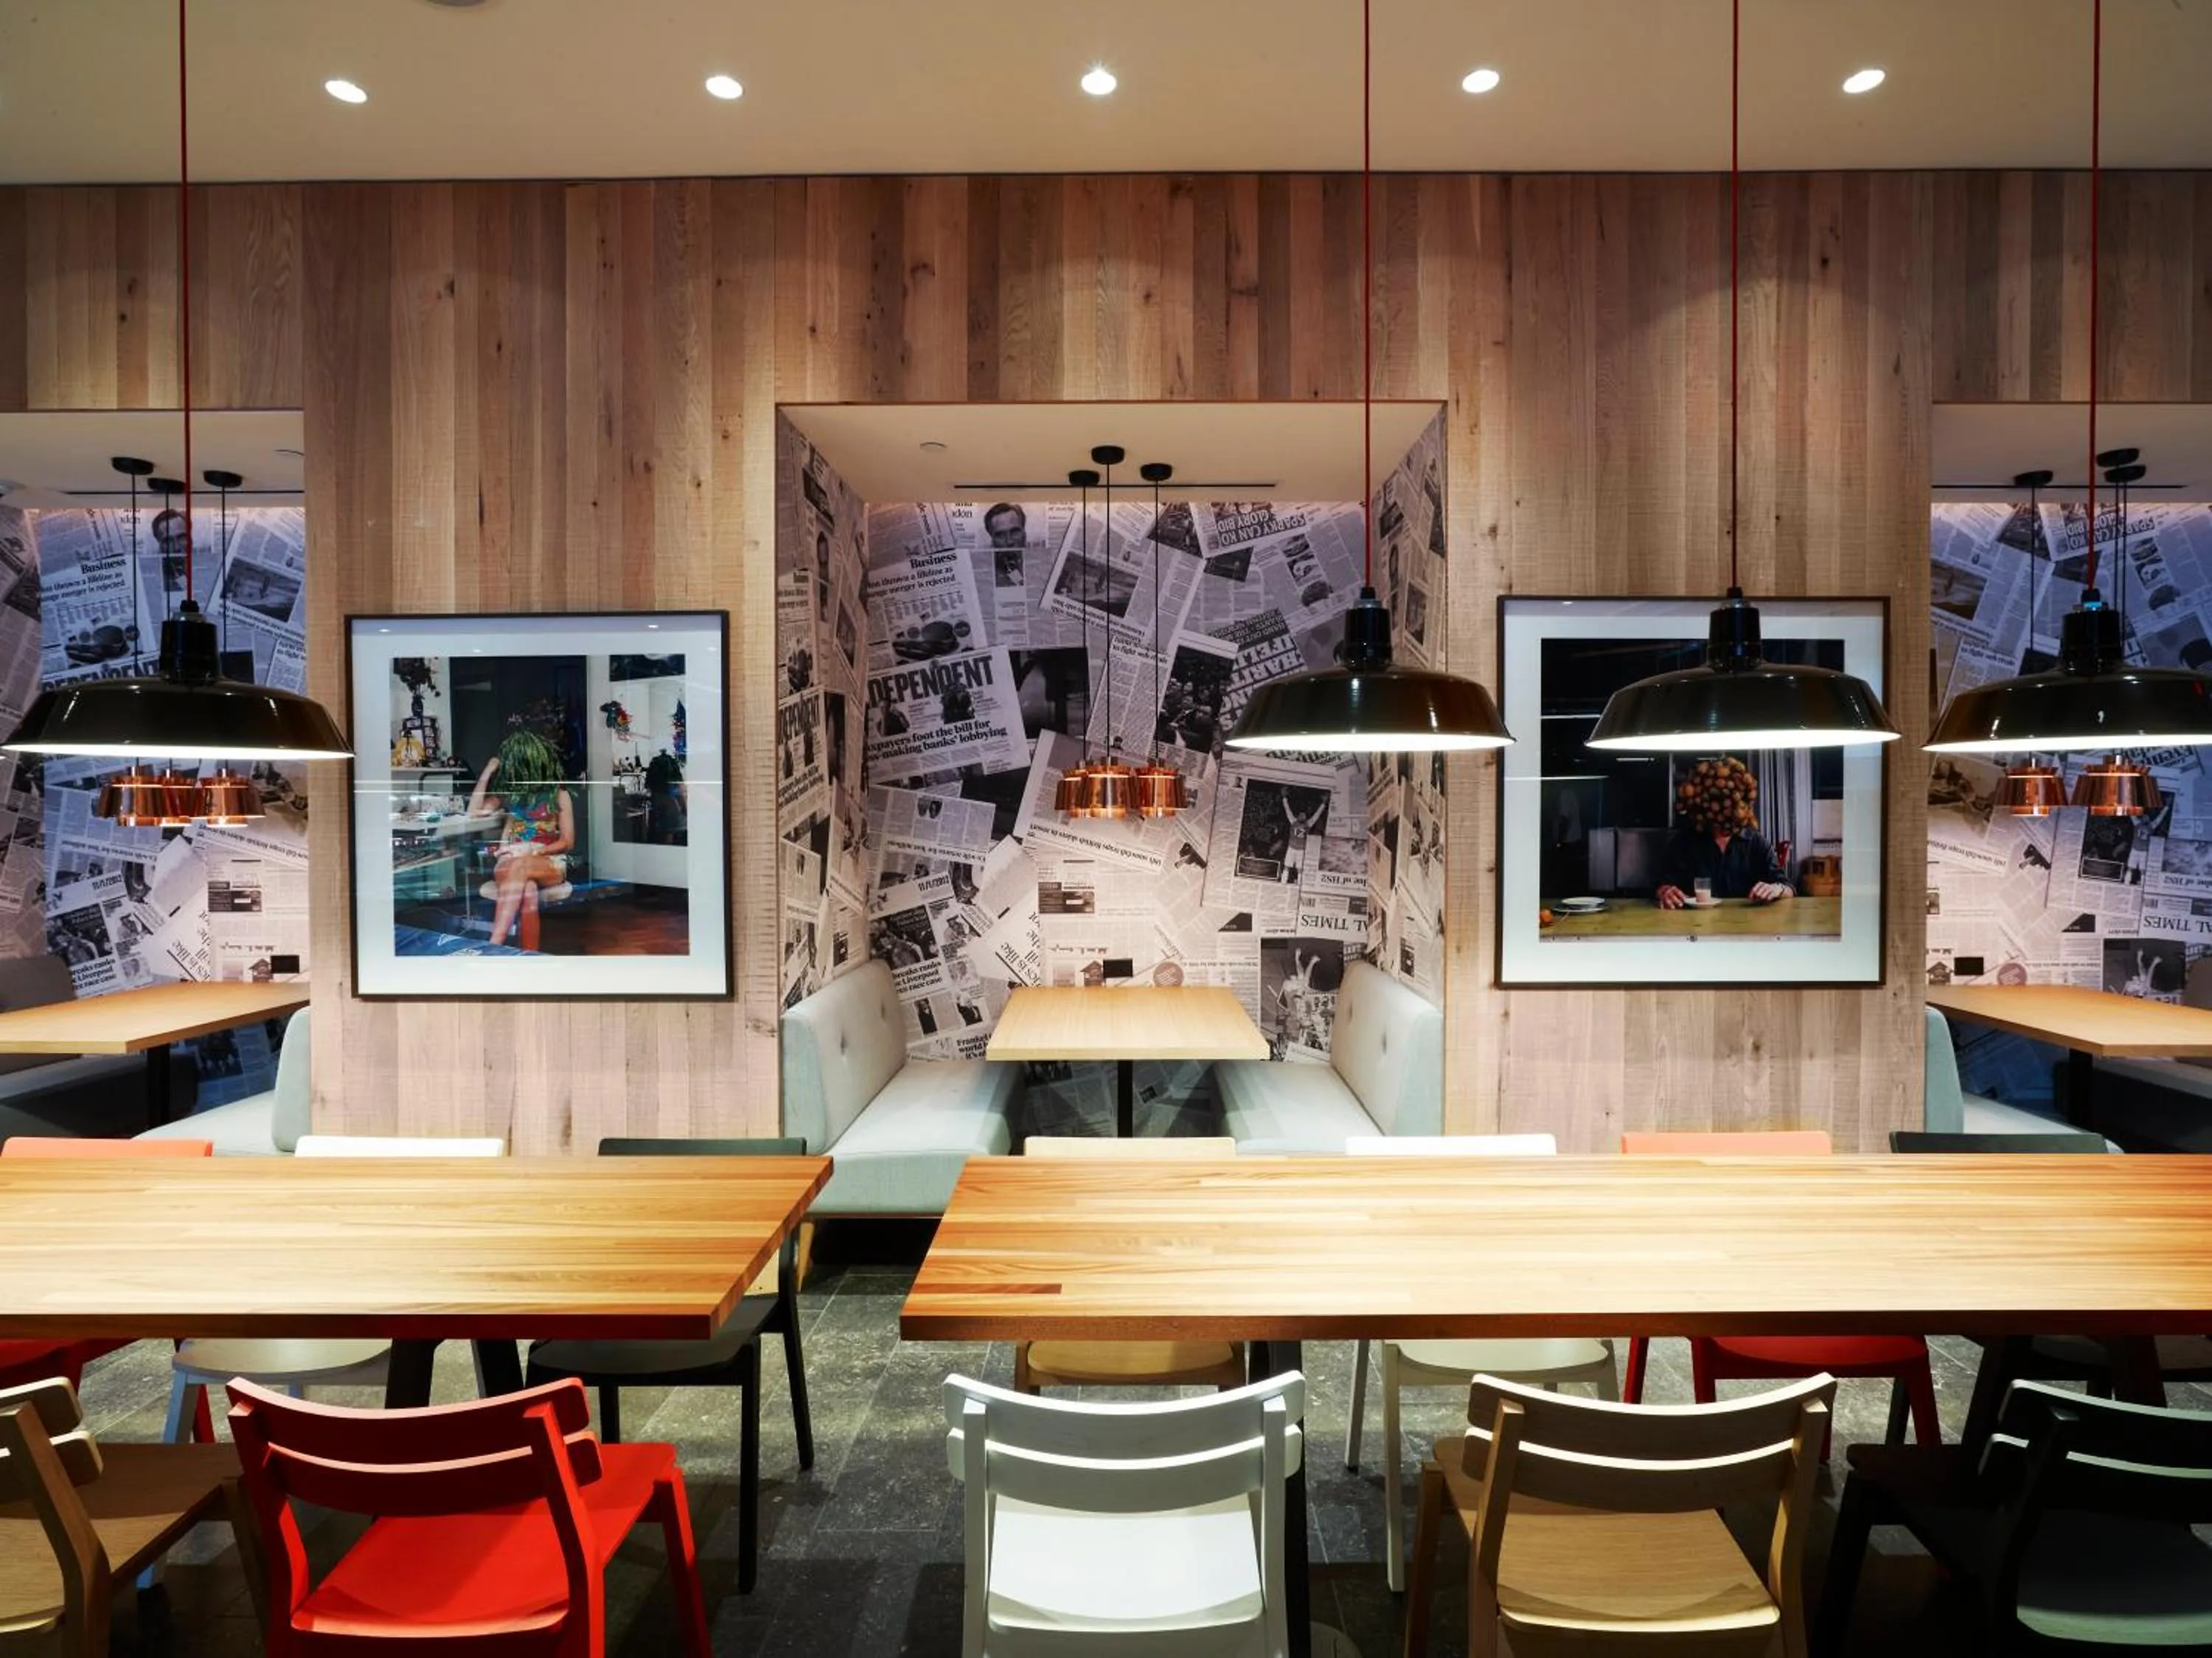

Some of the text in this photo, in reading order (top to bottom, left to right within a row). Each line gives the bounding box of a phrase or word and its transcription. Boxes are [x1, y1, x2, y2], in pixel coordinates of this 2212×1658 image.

[1217, 518, 1235, 532] BID
[1220, 512, 1305, 546] SPARKY CAN KO
[80, 558, 128, 574] Business
[910, 552, 957, 569] Business
[925, 575, 956, 588] rejected
[911, 729, 935, 743] foot
[935, 726, 953, 738] the
[953, 723, 973, 735] bill
[973, 719, 991, 730] for
[959, 727, 1007, 743] lobbying
[1301, 914, 1349, 931] TIMES
[2143, 915, 2192, 932] TIMES
[1001, 942, 1020, 964] like
